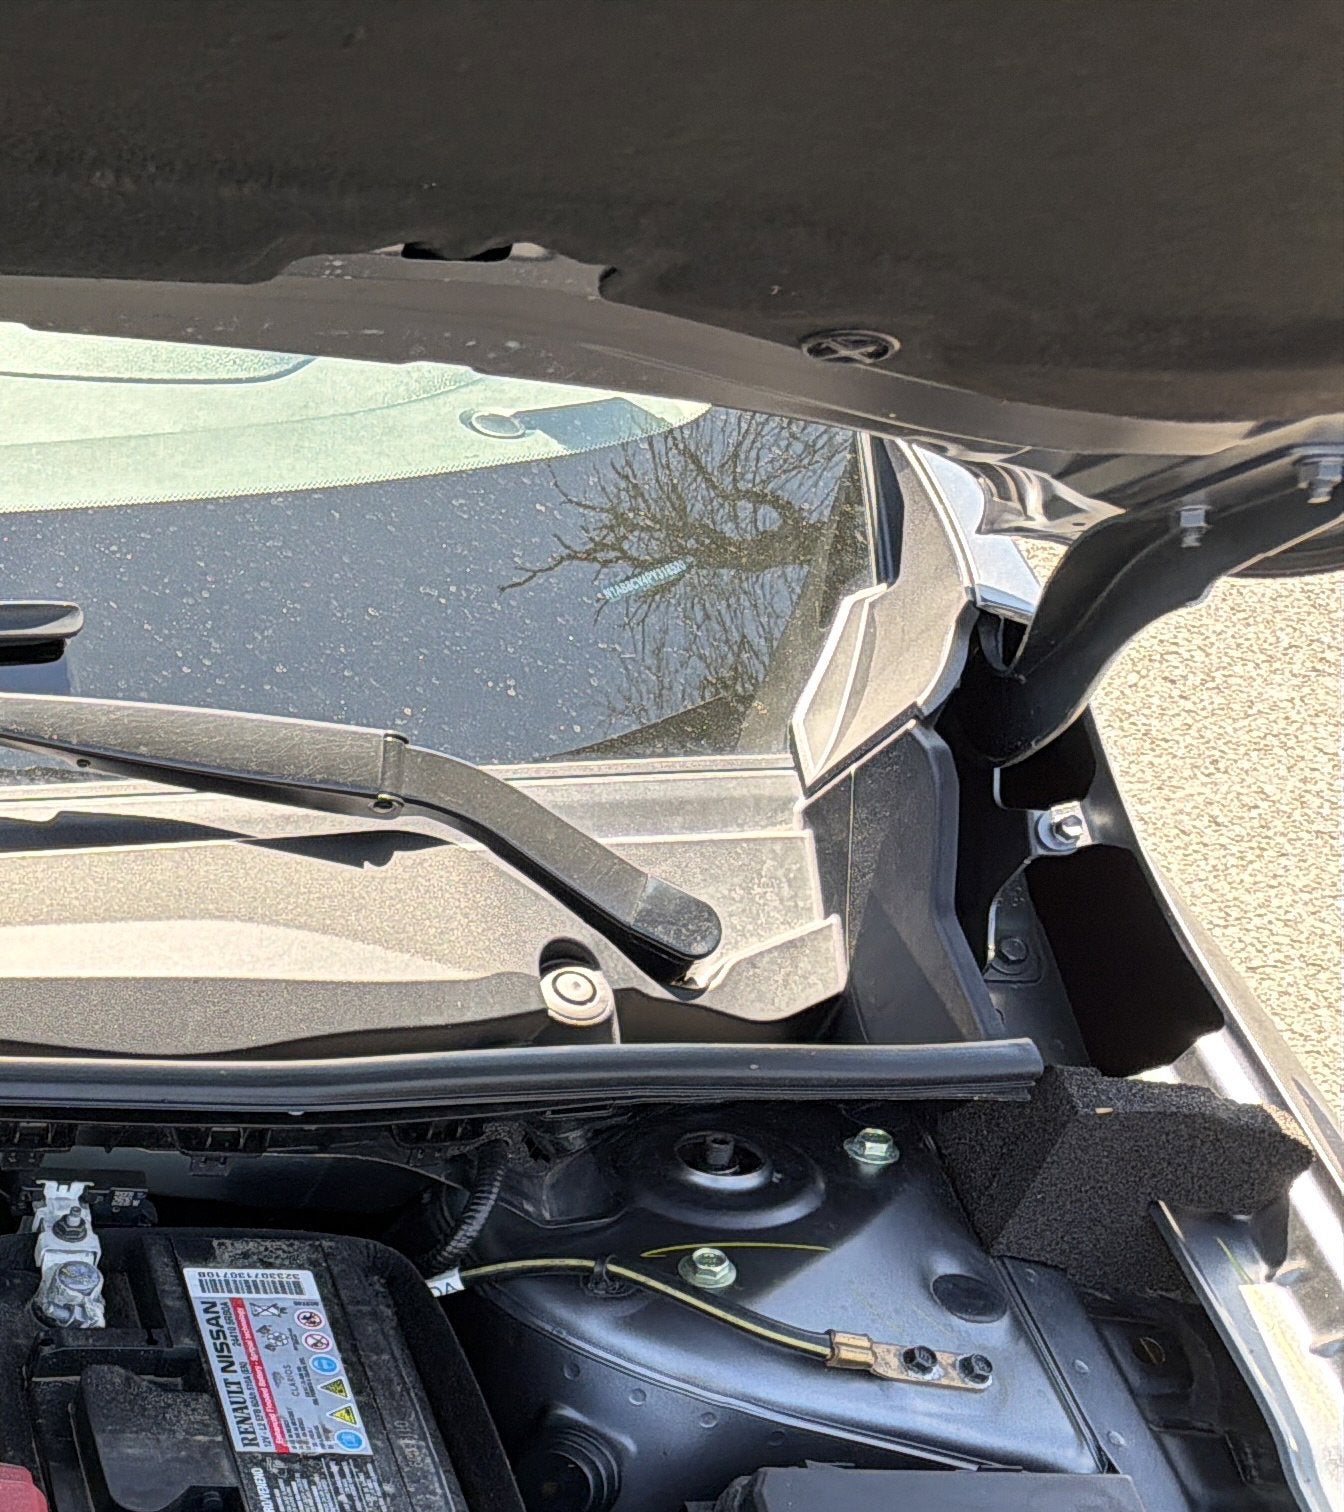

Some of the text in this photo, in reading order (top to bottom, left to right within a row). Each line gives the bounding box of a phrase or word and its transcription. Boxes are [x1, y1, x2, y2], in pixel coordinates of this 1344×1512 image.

[200, 1300, 260, 1448] RENAULT NISSAN
[283, 1364, 300, 1397] CLARIOS
